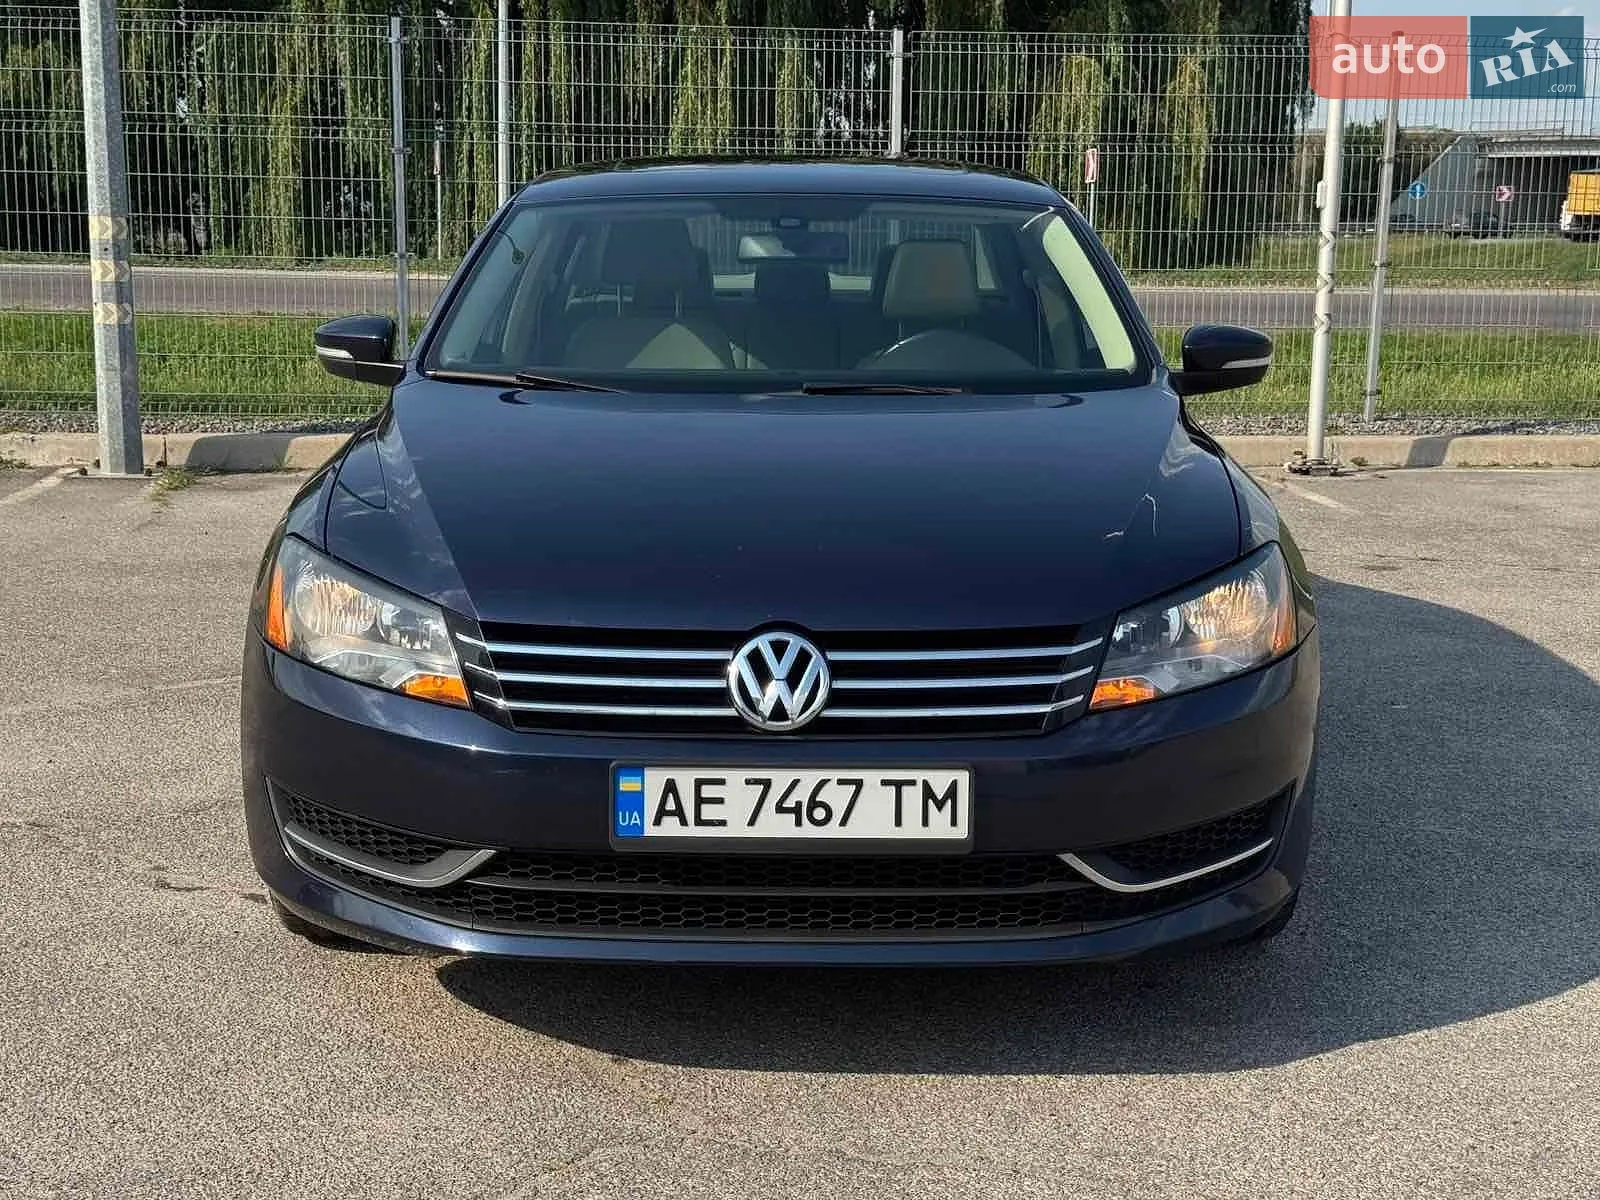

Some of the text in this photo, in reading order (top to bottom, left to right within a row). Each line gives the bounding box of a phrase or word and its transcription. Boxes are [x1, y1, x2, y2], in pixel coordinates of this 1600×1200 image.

[618, 810, 641, 827] UA
[652, 777, 959, 828] AE 7467 TM
